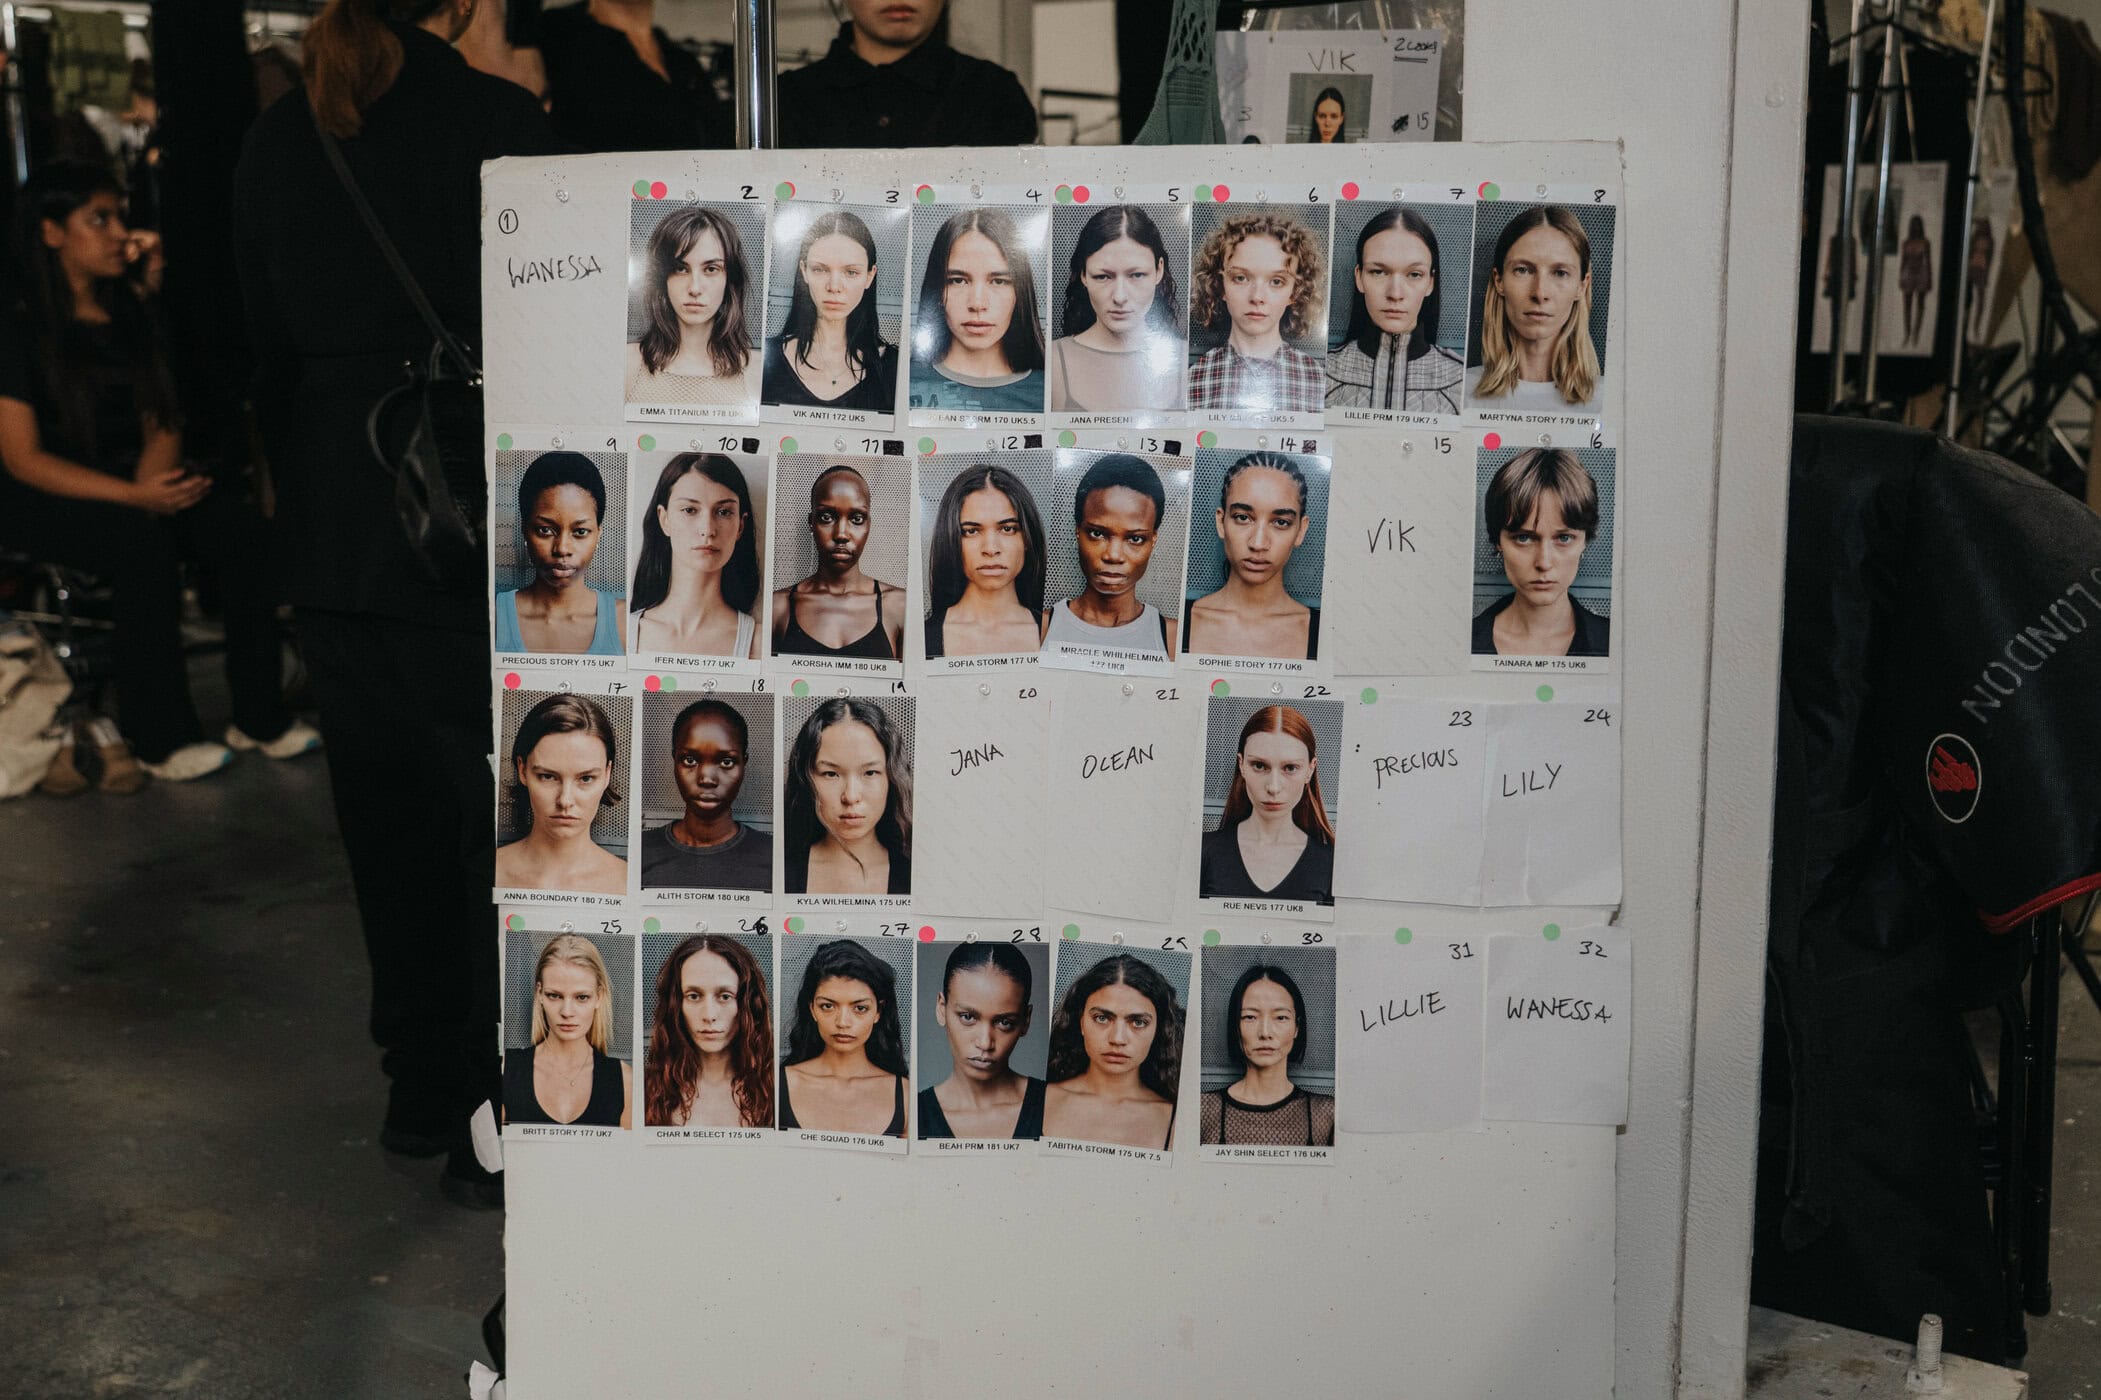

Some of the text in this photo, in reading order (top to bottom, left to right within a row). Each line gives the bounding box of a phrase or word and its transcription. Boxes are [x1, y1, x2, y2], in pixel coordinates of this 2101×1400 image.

[1395, 37, 1405, 51] 2
[1308, 50, 1356, 72] VIK
[1416, 112, 1429, 130] 15
[741, 186, 758, 199] 2
[885, 190, 898, 203] 3
[1026, 189, 1042, 203] 4
[1168, 188, 1180, 202] 5
[1308, 188, 1319, 203] 6
[1449, 189, 1466, 200] 7
[1594, 189, 1606, 203] 8
[508, 255, 602, 288] WANESSA
[640, 407, 665, 416] EMMA
[668, 408, 710, 417] TITANIUM
[793, 410, 866, 423] VIK ANTI 172 UK5
[1208, 413, 1227, 422] LILY
[1344, 412, 1438, 425] LILLIE PRM 179 UK7.5
[994, 416, 1008, 425] 170
[1011, 417, 1036, 425] UK5.5
[1070, 416, 1092, 425] JANA
[1479, 413, 1595, 426] MARTYNA STORY 179 UK7
[607, 437, 617, 451] 9
[718, 437, 737, 451] 10
[1002, 436, 1018, 450] 12
[1141, 438, 1158, 452] 13
[1280, 437, 1297, 452] 14
[1434, 437, 1452, 453] 15
[1590, 433, 1602, 449] 16
[1061, 646, 1100, 658] MIRACLE
[502, 657, 547, 665] PRECIOUS
[549, 658, 579, 666] STORY
[582, 659, 596, 667] 175
[655, 657, 674, 665] IFER
[677, 658, 700, 666] NEVS
[718, 660, 735, 668] UK7
[792, 659, 887, 672] AKORSHA IMM 180 UK8
[948, 660, 974, 668] SOFIA
[976, 658, 1008, 667] STORM
[1010, 657, 1024, 665] 177
[1199, 658, 1302, 671] SOPHIE STORY 177 UK6
[1494, 659, 1586, 669] TAINARA MP 175 UK6
[608, 682, 627, 694] 17
[752, 679, 765, 692] 18
[891, 681, 906, 693] 19
[1303, 686, 1331, 698] 22
[1018, 688, 1037, 699] 20
[1156, 688, 1180, 700] 21
[1449, 711, 1473, 727] 23
[1584, 709, 1611, 727] 24
[951, 744, 1004, 776] JANA
[1082, 744, 1154, 779] OCEAN
[1373, 749, 1458, 789] PRECIOUS
[1502, 763, 1562, 797] LILY
[504, 892, 528, 901] ANNA
[530, 894, 578, 903] BOUNDARY
[581, 896, 596, 904] 180
[657, 892, 682, 900] ALITH
[684, 892, 715, 901] STORM
[734, 894, 751, 902] UK8
[797, 898, 820, 906] KYLA
[822, 898, 877, 906] WILHELMINA
[1223, 901, 1241, 910] RUE
[1244, 902, 1268, 911] NEVS
[1286, 904, 1304, 913] UK8
[600, 919, 622, 933] 25
[880, 923, 910, 936] 27
[1011, 927, 1041, 944] 28
[1302, 933, 1323, 945] 30
[1448, 942, 1474, 960] 31
[1579, 941, 1608, 958] 32
[1360, 991, 1446, 1032] LILLIE
[1507, 997, 1612, 1023] WANESSA
[522, 1128, 612, 1138] BRITT STORY 177 UK7
[693, 1131, 725, 1139] SELECT
[728, 1131, 742, 1139] 175
[744, 1131, 762, 1139] UK5
[801, 1133, 885, 1147] CHE SQUAD 176 UK6
[939, 1142, 962, 1150] BEAH
[1003, 1143, 1020, 1151] UK7
[1047, 1141, 1161, 1161] TABITHA STORM 175 UK 7.5
[1215, 1149, 1231, 1157] JAY
[1234, 1149, 1255, 1157] SHIN
[1257, 1150, 1290, 1158] SELECT
